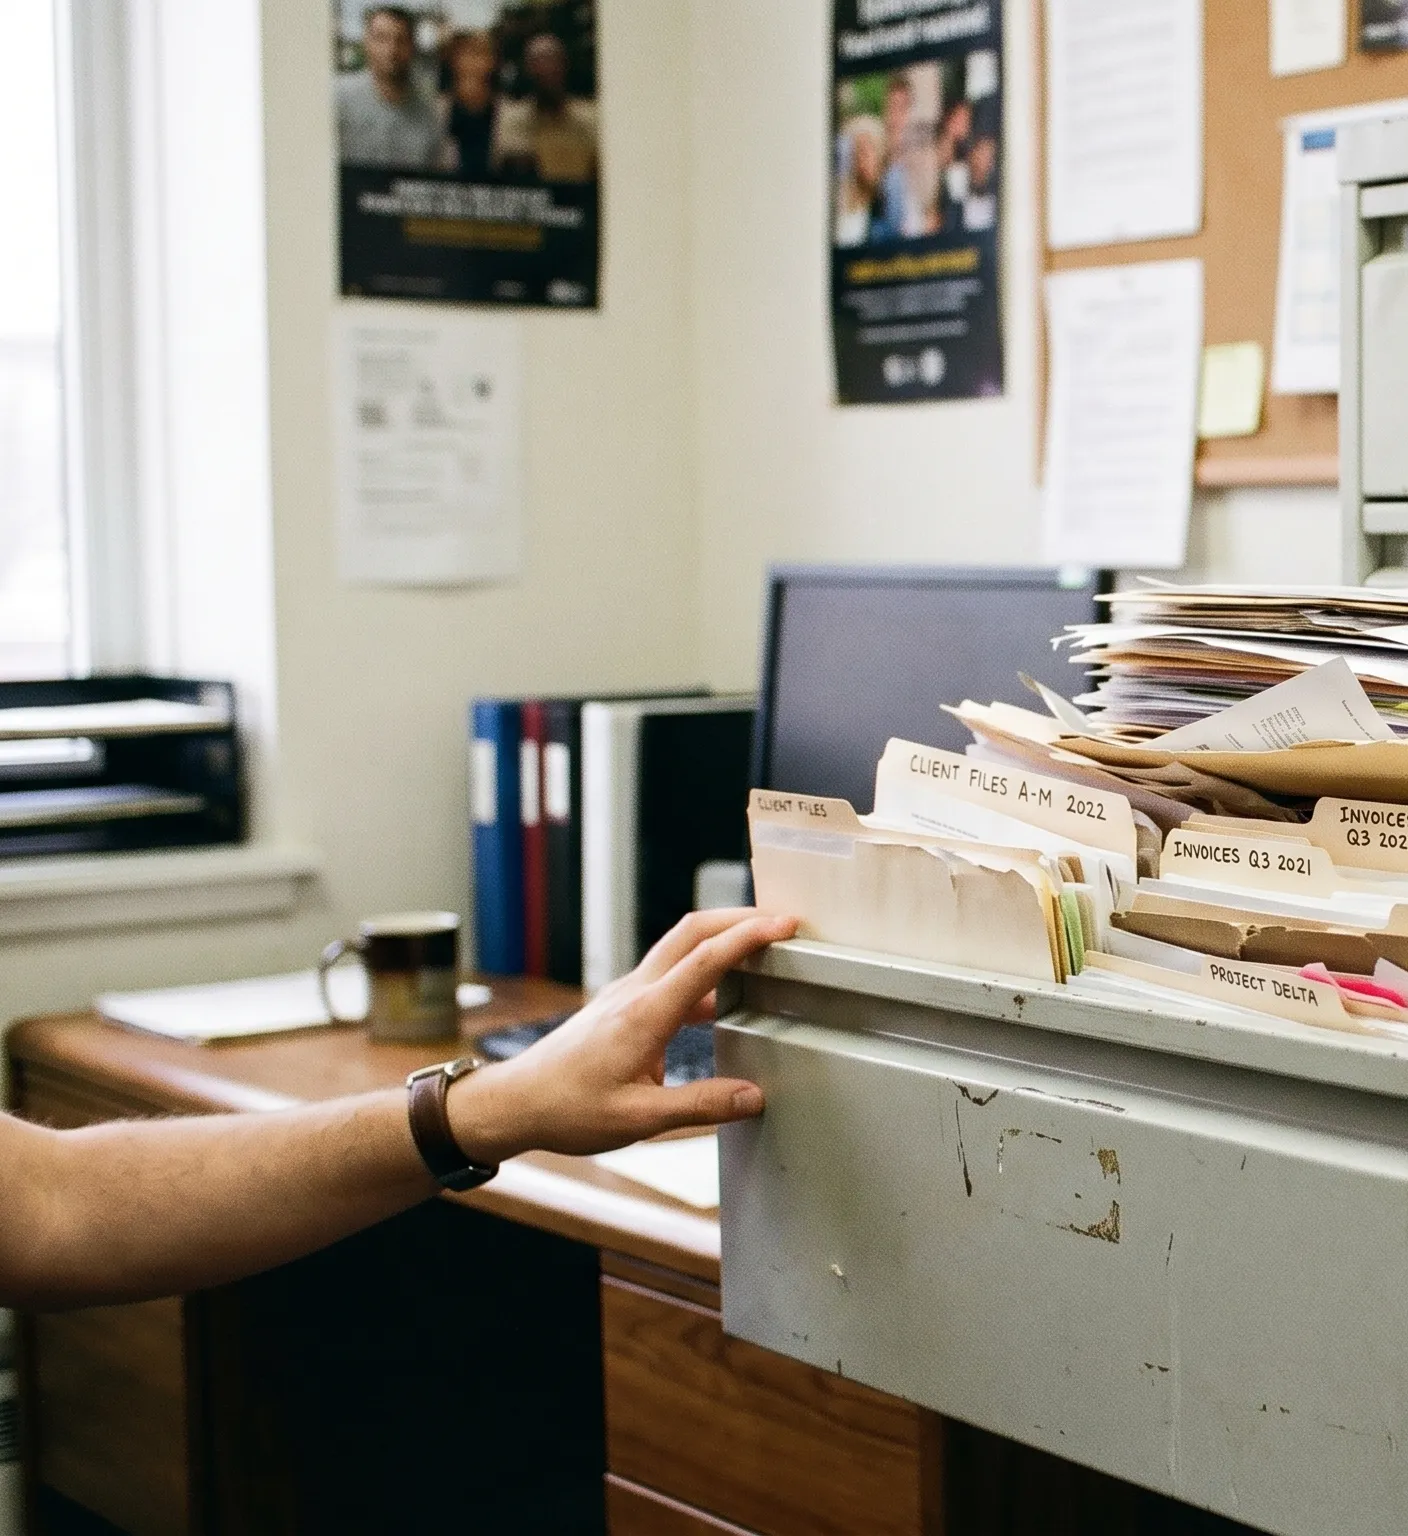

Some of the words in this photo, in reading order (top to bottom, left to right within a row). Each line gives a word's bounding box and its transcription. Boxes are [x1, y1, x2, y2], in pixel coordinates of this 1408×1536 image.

[910, 754, 960, 782] CLIENT
[969, 768, 1009, 796] FILES
[1018, 781, 1053, 808] A-M
[1066, 795, 1107, 821] 2022
[1346, 829, 1371, 847] Q3
[1174, 841, 1240, 864] INVOICES
[1248, 850, 1271, 870] Q3
[1278, 854, 1311, 876] 2021
[1210, 964, 1266, 992] PROJECT
[1272, 979, 1318, 1007] DELTA
